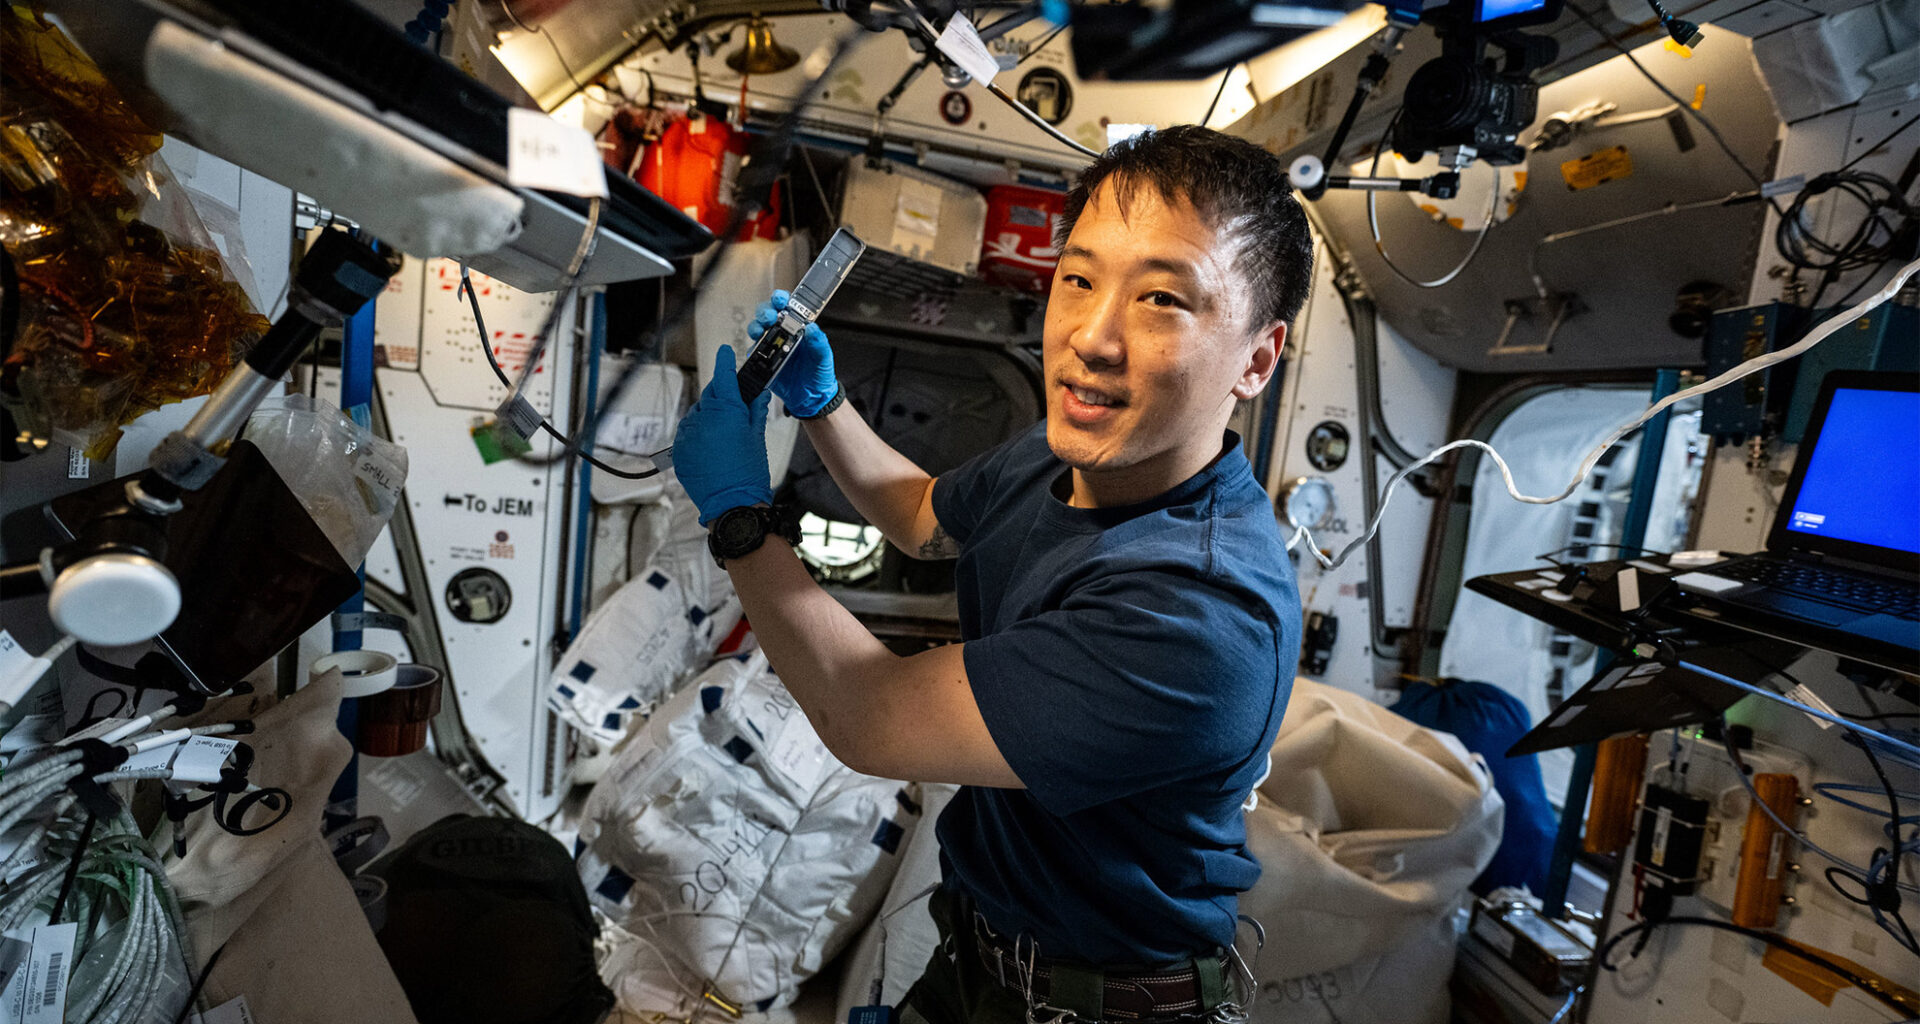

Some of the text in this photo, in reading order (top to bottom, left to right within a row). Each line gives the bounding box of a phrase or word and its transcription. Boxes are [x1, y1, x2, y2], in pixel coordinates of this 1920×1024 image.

[361, 462, 391, 491] SMALL
[464, 494, 534, 517] To JEM
[213, 741, 226, 749] USB
[220, 747, 229, 755] P1
[17, 969, 26, 990] USB-C
